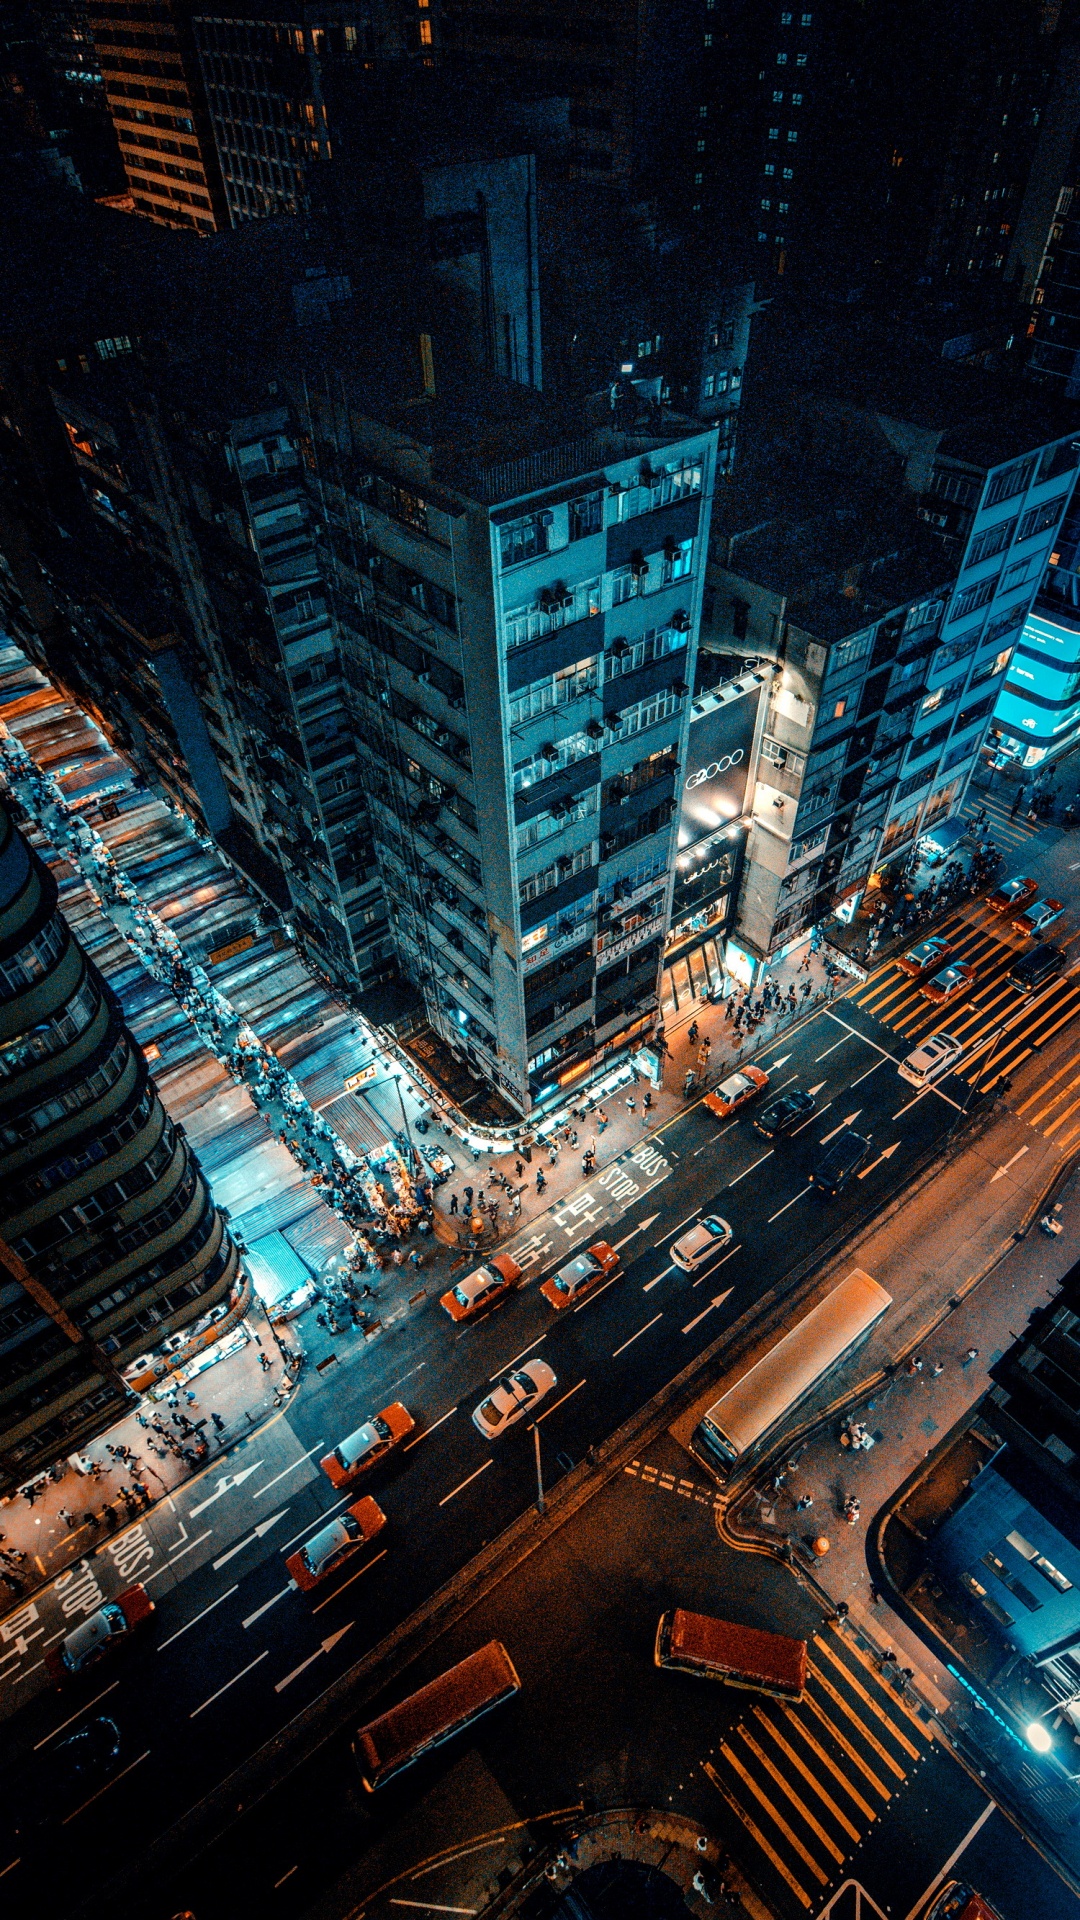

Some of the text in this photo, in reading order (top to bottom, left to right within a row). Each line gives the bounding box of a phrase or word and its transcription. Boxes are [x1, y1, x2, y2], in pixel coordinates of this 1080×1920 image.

[685, 748, 744, 790] G2000
[631, 1145, 668, 1177] BUS
[598, 1167, 640, 1202] STOP
[552, 1192, 604, 1236] 巴士
[107, 1524, 155, 1577] BUS
[54, 1559, 105, 1618] STOP
[958, 1676, 1032, 1753] BROADWAY
